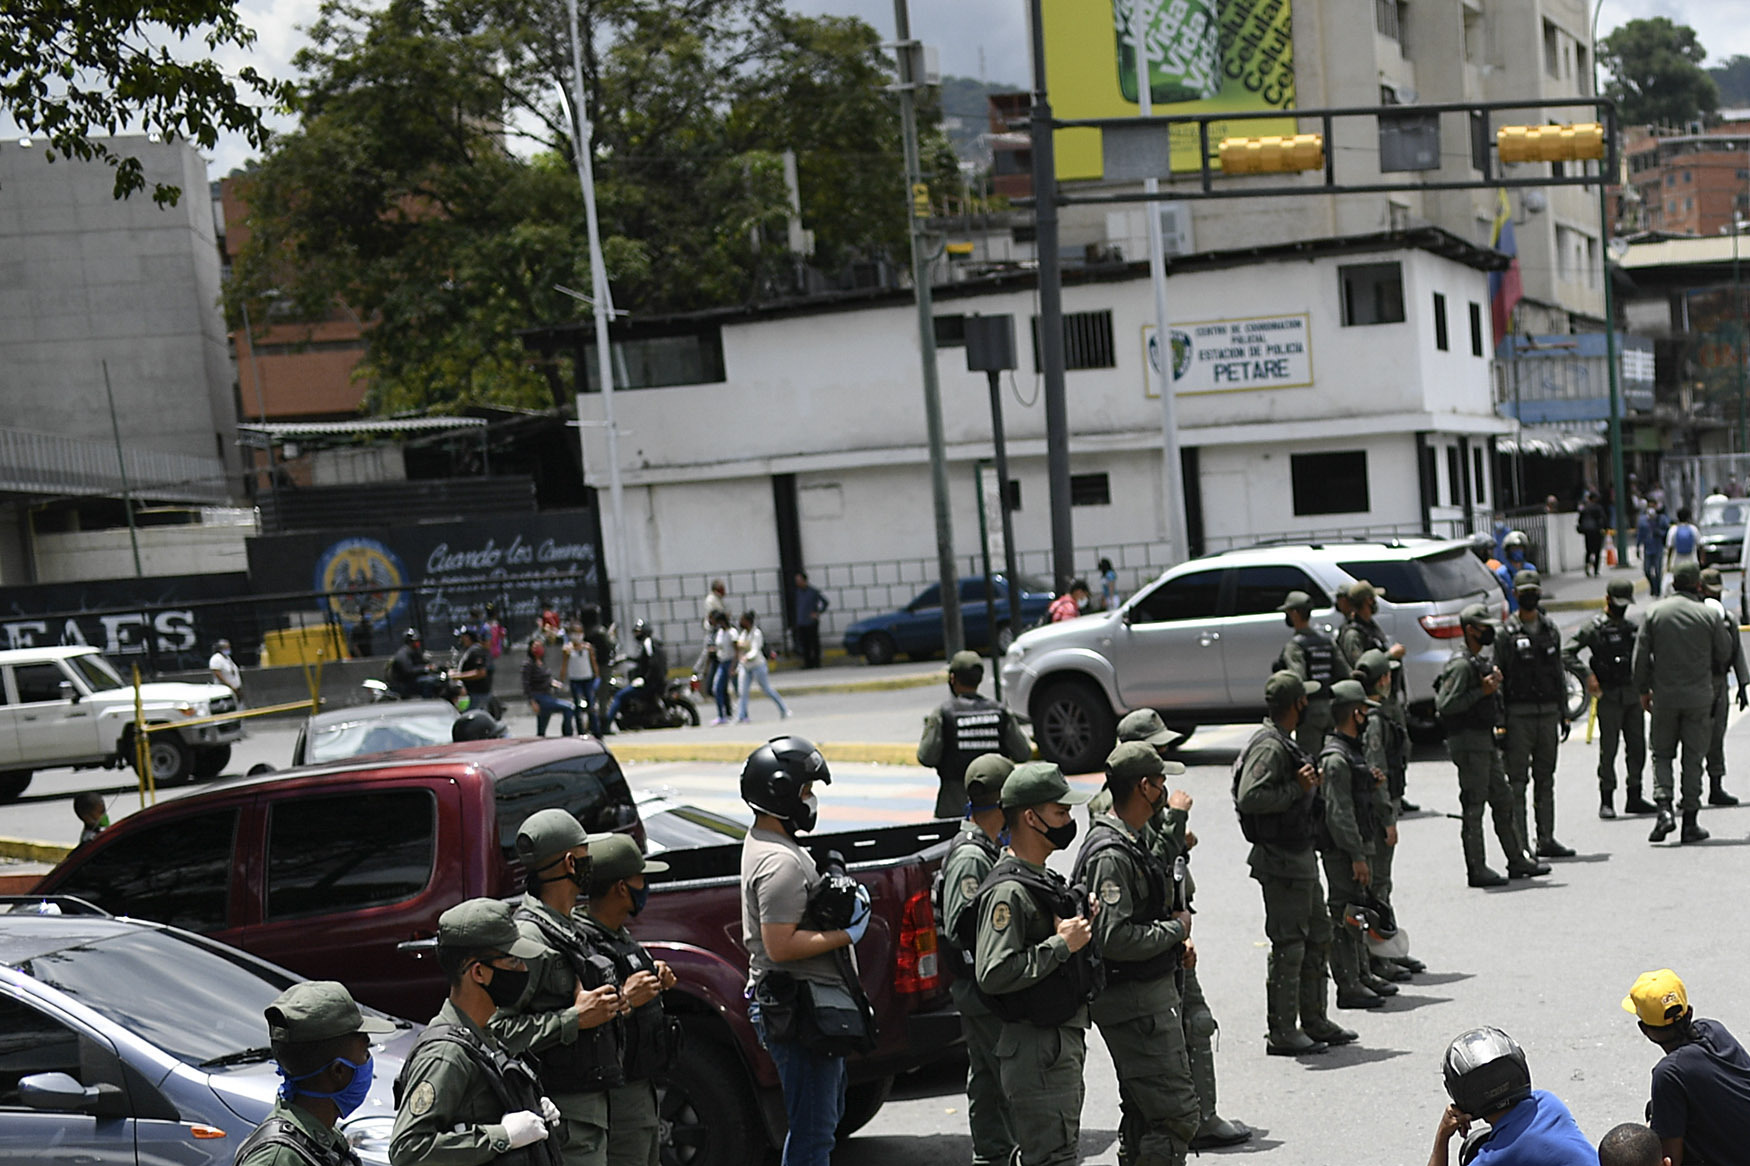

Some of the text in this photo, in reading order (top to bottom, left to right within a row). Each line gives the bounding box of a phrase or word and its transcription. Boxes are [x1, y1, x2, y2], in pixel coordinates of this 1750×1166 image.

[1140, 0, 1190, 62] Vida
[1159, 11, 1208, 76] Vida
[1181, 26, 1219, 88] Vida
[1213, 358, 1290, 383] PETARE
[1249, 346, 1261, 357] DE
[427, 538, 501, 573] Cuando
